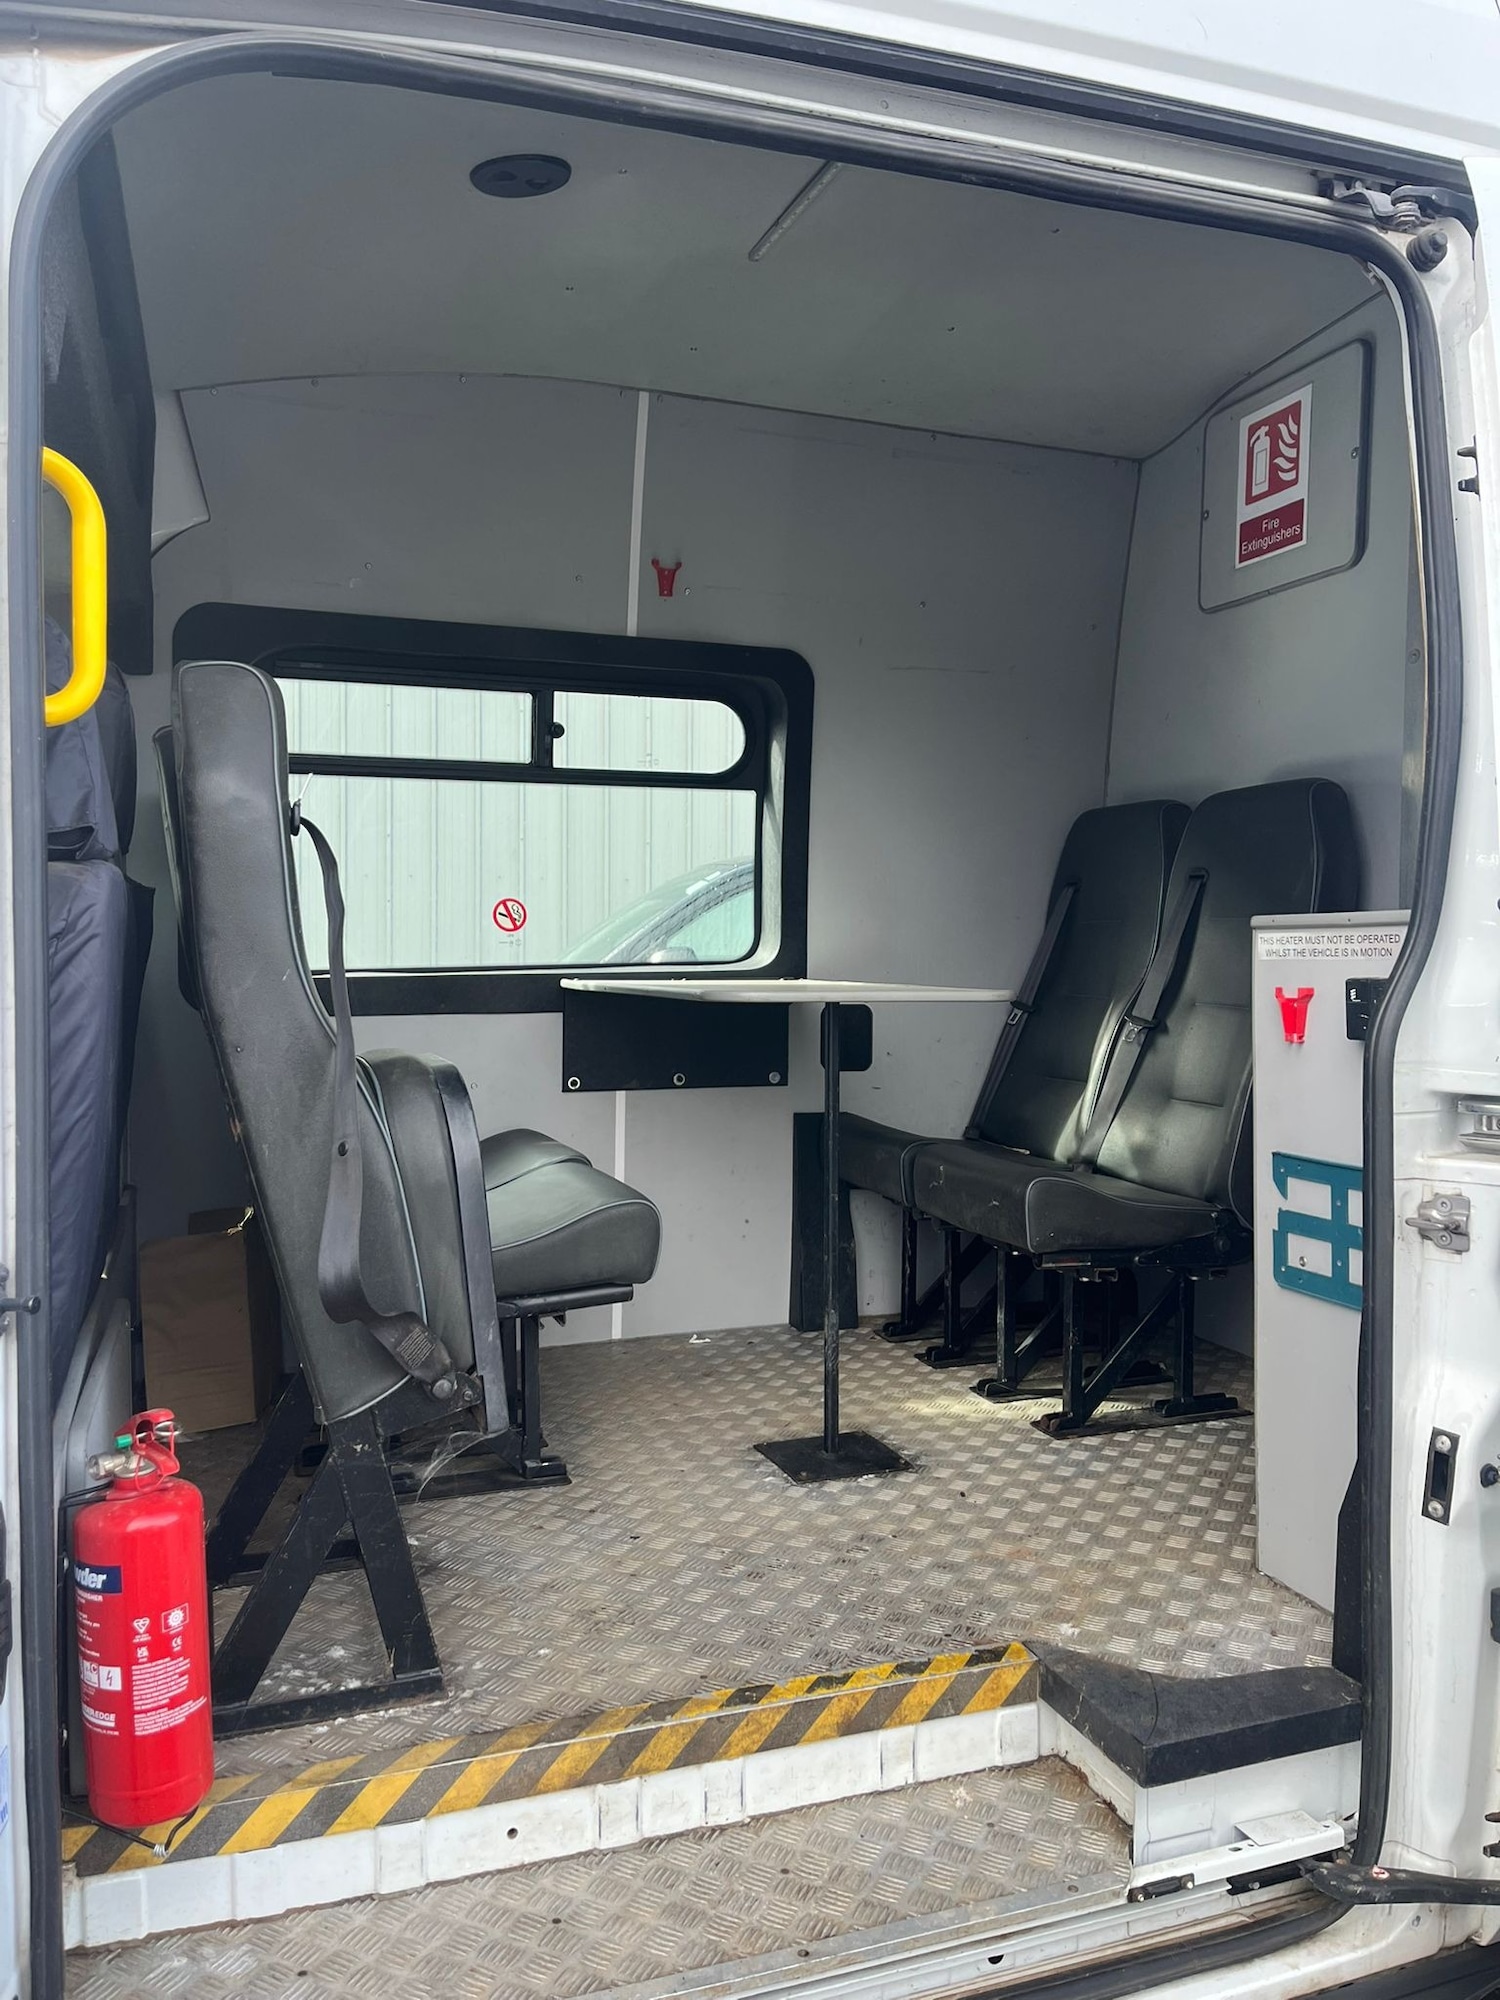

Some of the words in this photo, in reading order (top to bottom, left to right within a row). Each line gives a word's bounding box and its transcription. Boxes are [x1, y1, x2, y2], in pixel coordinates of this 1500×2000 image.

[1262, 518, 1280, 533] Fire
[1241, 524, 1301, 554] Extinguishers
[1259, 936, 1275, 946] THIS
[1276, 936, 1304, 945] HEATER
[1305, 935, 1326, 945] MUST
[1327, 935, 1343, 944] NOT
[1345, 935, 1356, 944] BE
[1357, 934, 1401, 944] OPERATED
[1265, 948, 1292, 958] WHILST
[1292, 948, 1307, 957] THE
[1308, 948, 1340, 957] VEHICLE
[1341, 947, 1349, 957] IS
[1351, 948, 1359, 957] IN
[1360, 947, 1393, 957] MOTION
